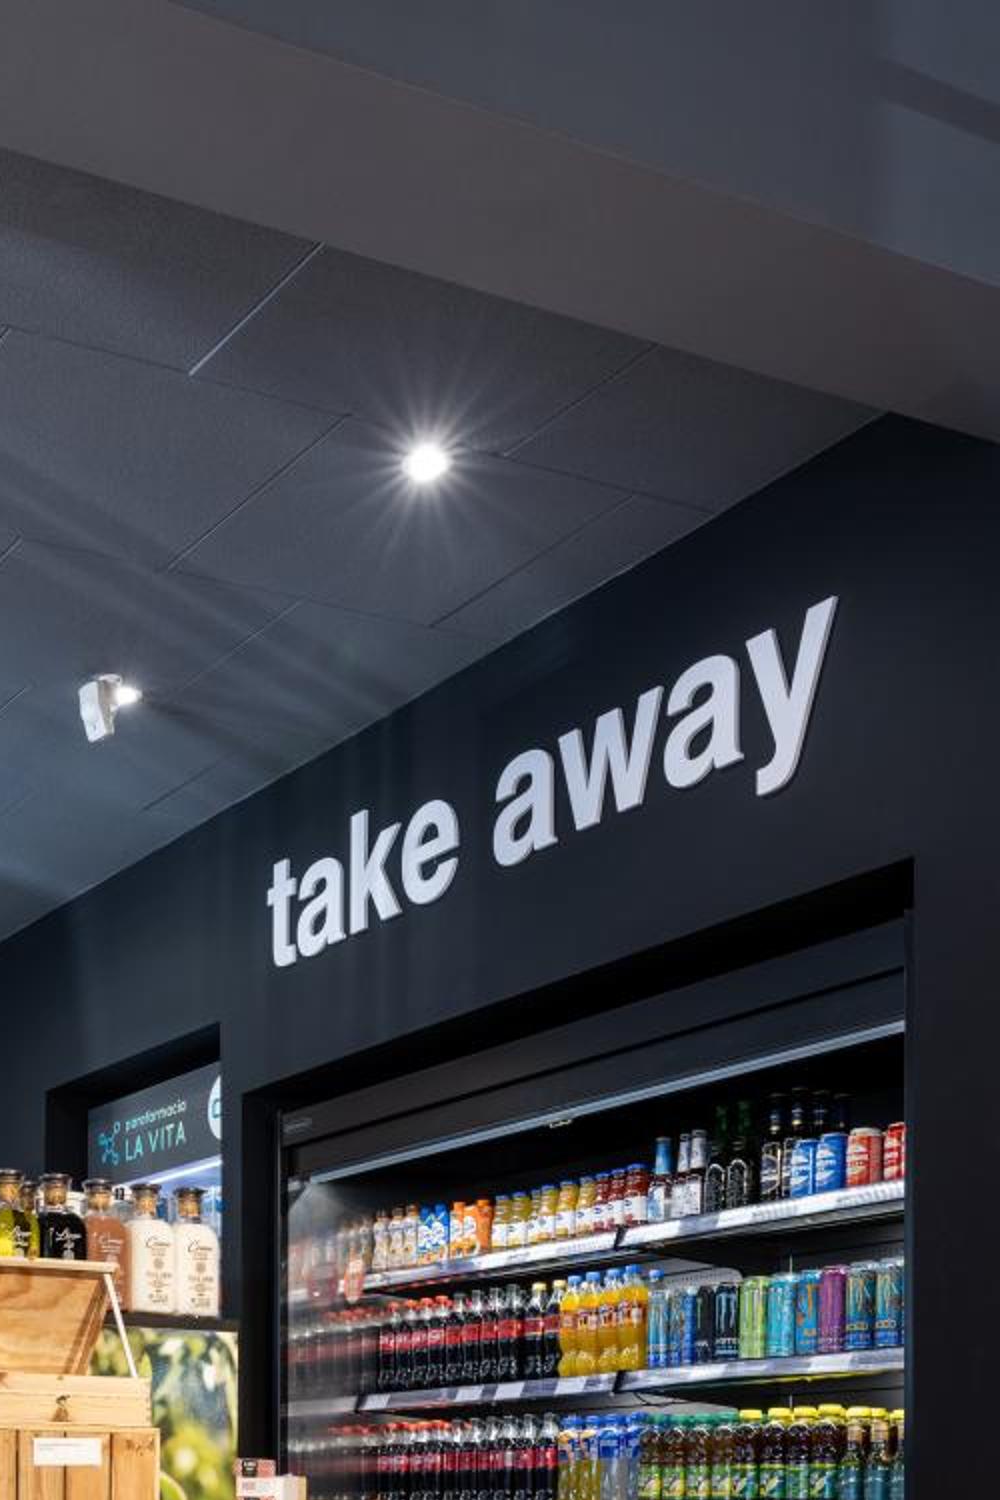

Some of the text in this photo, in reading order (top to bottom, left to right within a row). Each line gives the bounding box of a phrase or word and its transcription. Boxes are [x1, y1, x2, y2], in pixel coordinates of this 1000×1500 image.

[266, 595, 839, 968] take away
[124, 1120, 188, 1161] LA VITA
